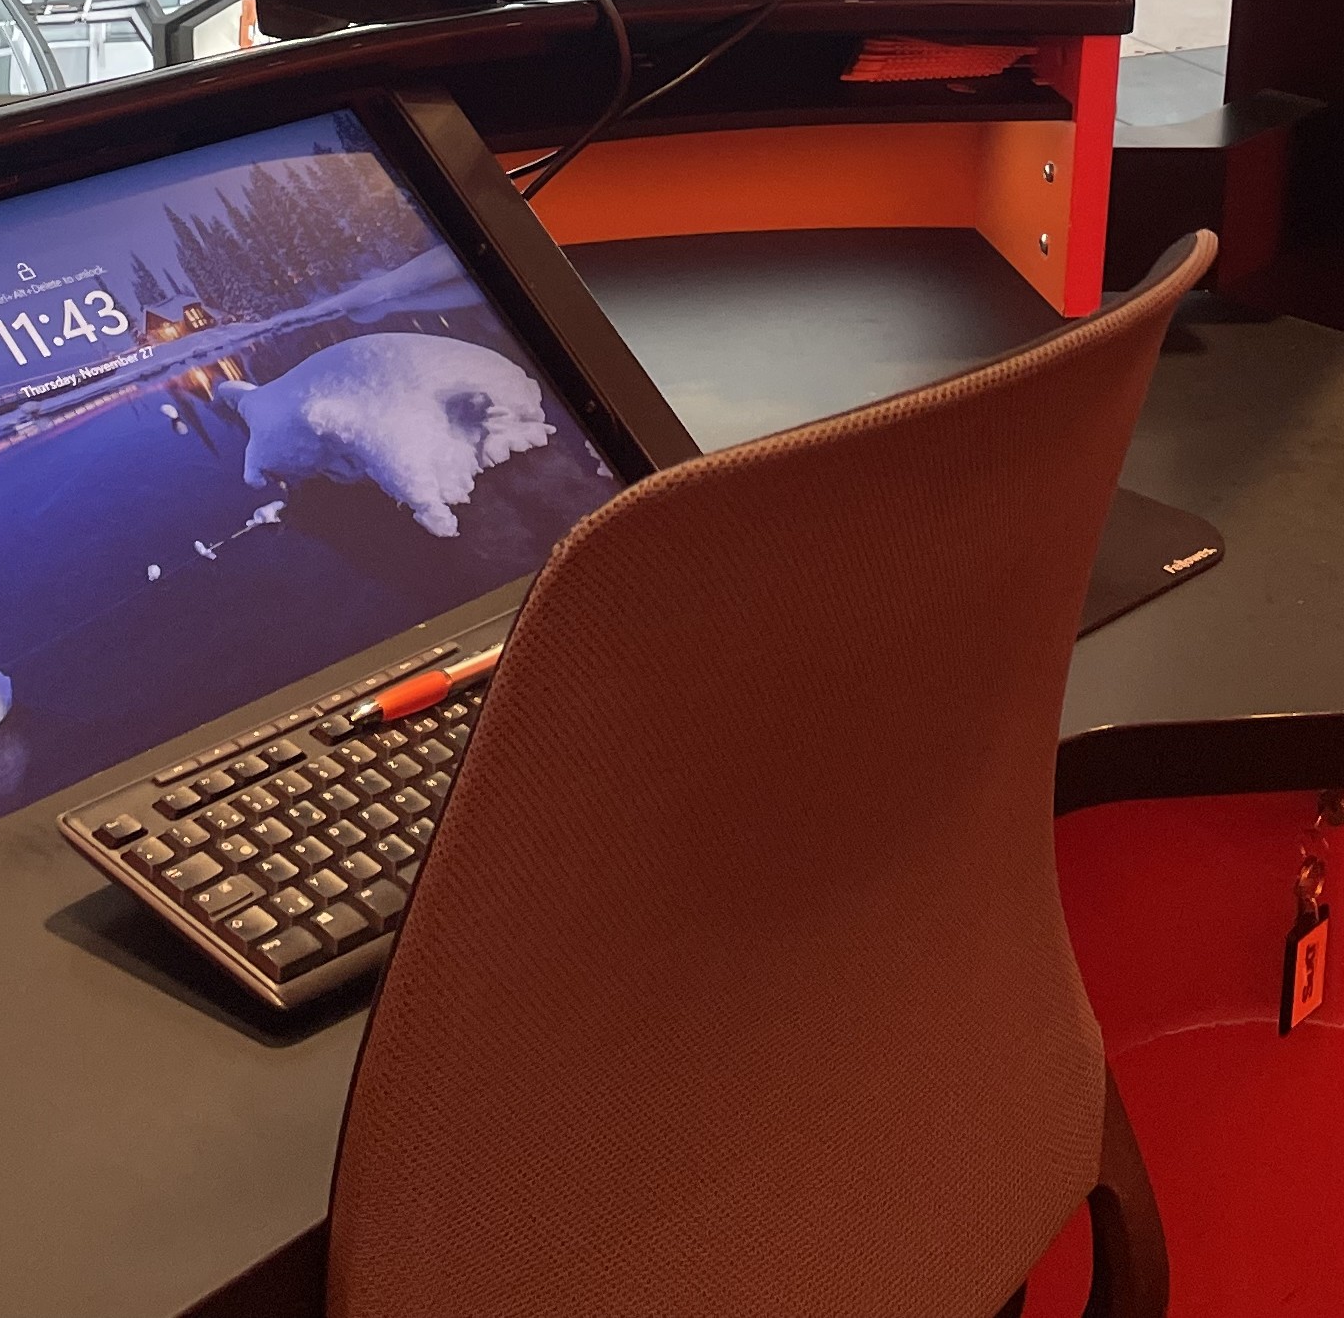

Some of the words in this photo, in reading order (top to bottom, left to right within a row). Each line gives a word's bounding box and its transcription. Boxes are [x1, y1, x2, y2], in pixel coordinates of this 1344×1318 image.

[19, 371, 82, 399] Thursday,
[79, 350, 139, 380] November
[139, 345, 155, 359] 27
